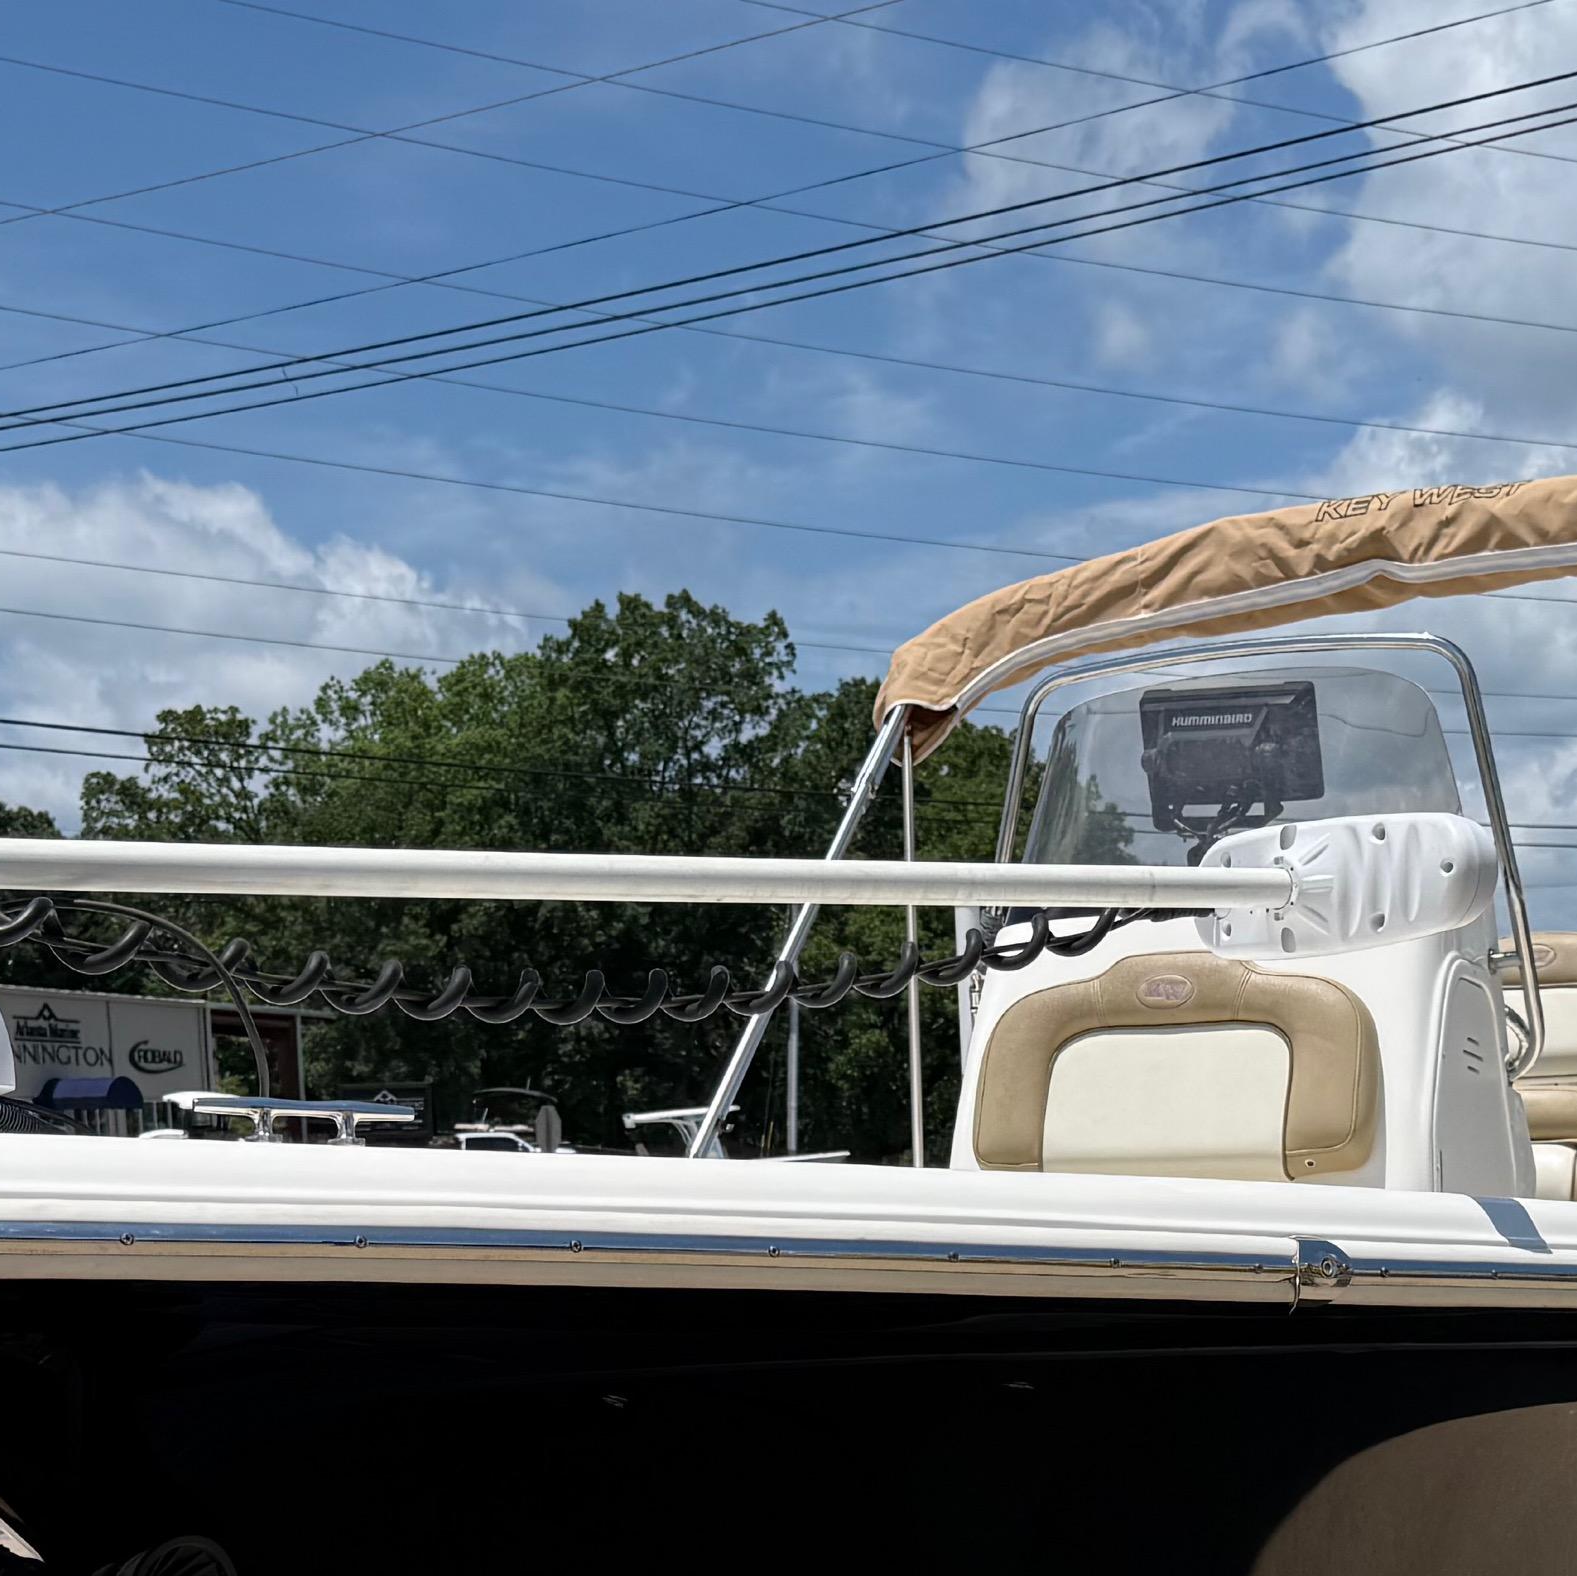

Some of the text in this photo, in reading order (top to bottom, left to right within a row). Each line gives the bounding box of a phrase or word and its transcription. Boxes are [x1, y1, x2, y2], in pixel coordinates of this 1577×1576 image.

[1315, 480, 1530, 522] KEY WEST
[1171, 713, 1253, 727] HUMMINBIRD
